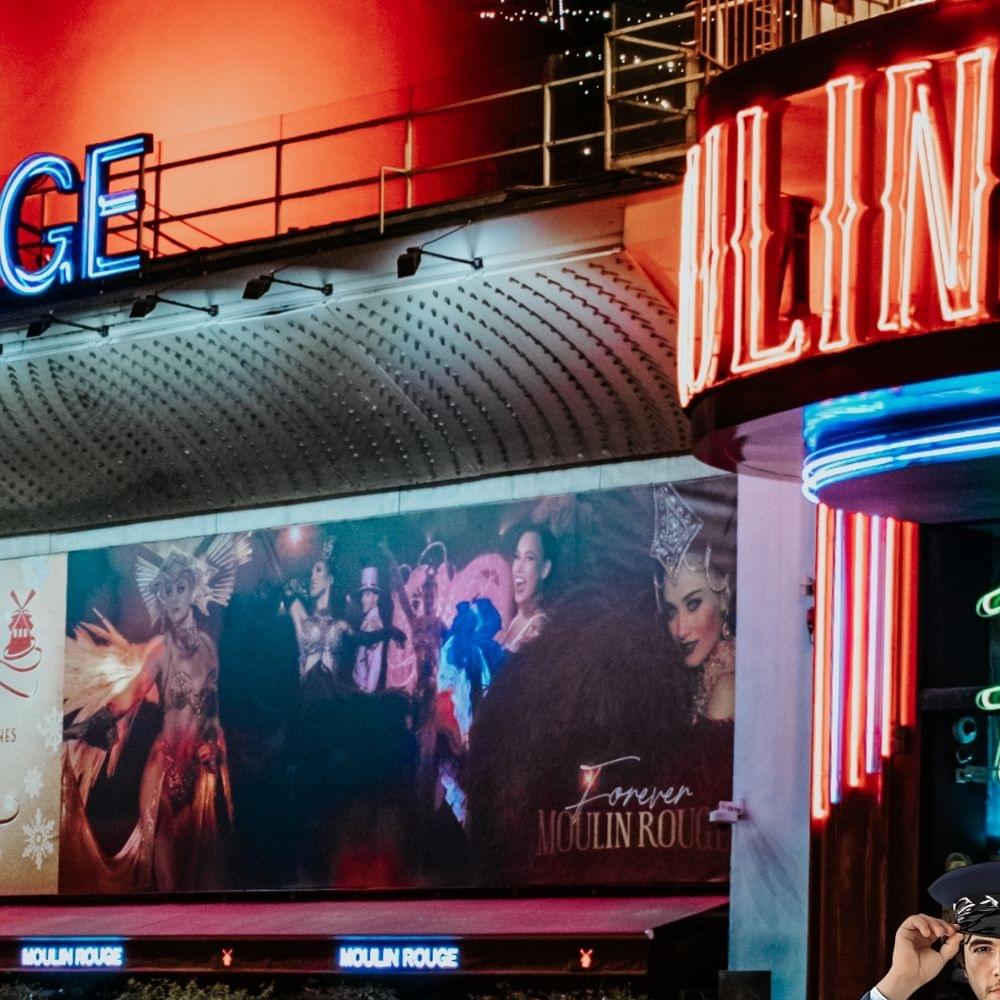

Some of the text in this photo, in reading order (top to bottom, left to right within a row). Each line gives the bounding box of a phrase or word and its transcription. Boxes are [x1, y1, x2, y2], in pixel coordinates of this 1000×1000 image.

[0, 132, 153, 296] GE
[564, 755, 693, 824] Forever
[535, 809, 631, 857] MOULIN
[21, 946, 123, 967] MOULIN ROUGE
[339, 946, 459, 968] MOULIN ROUGE
